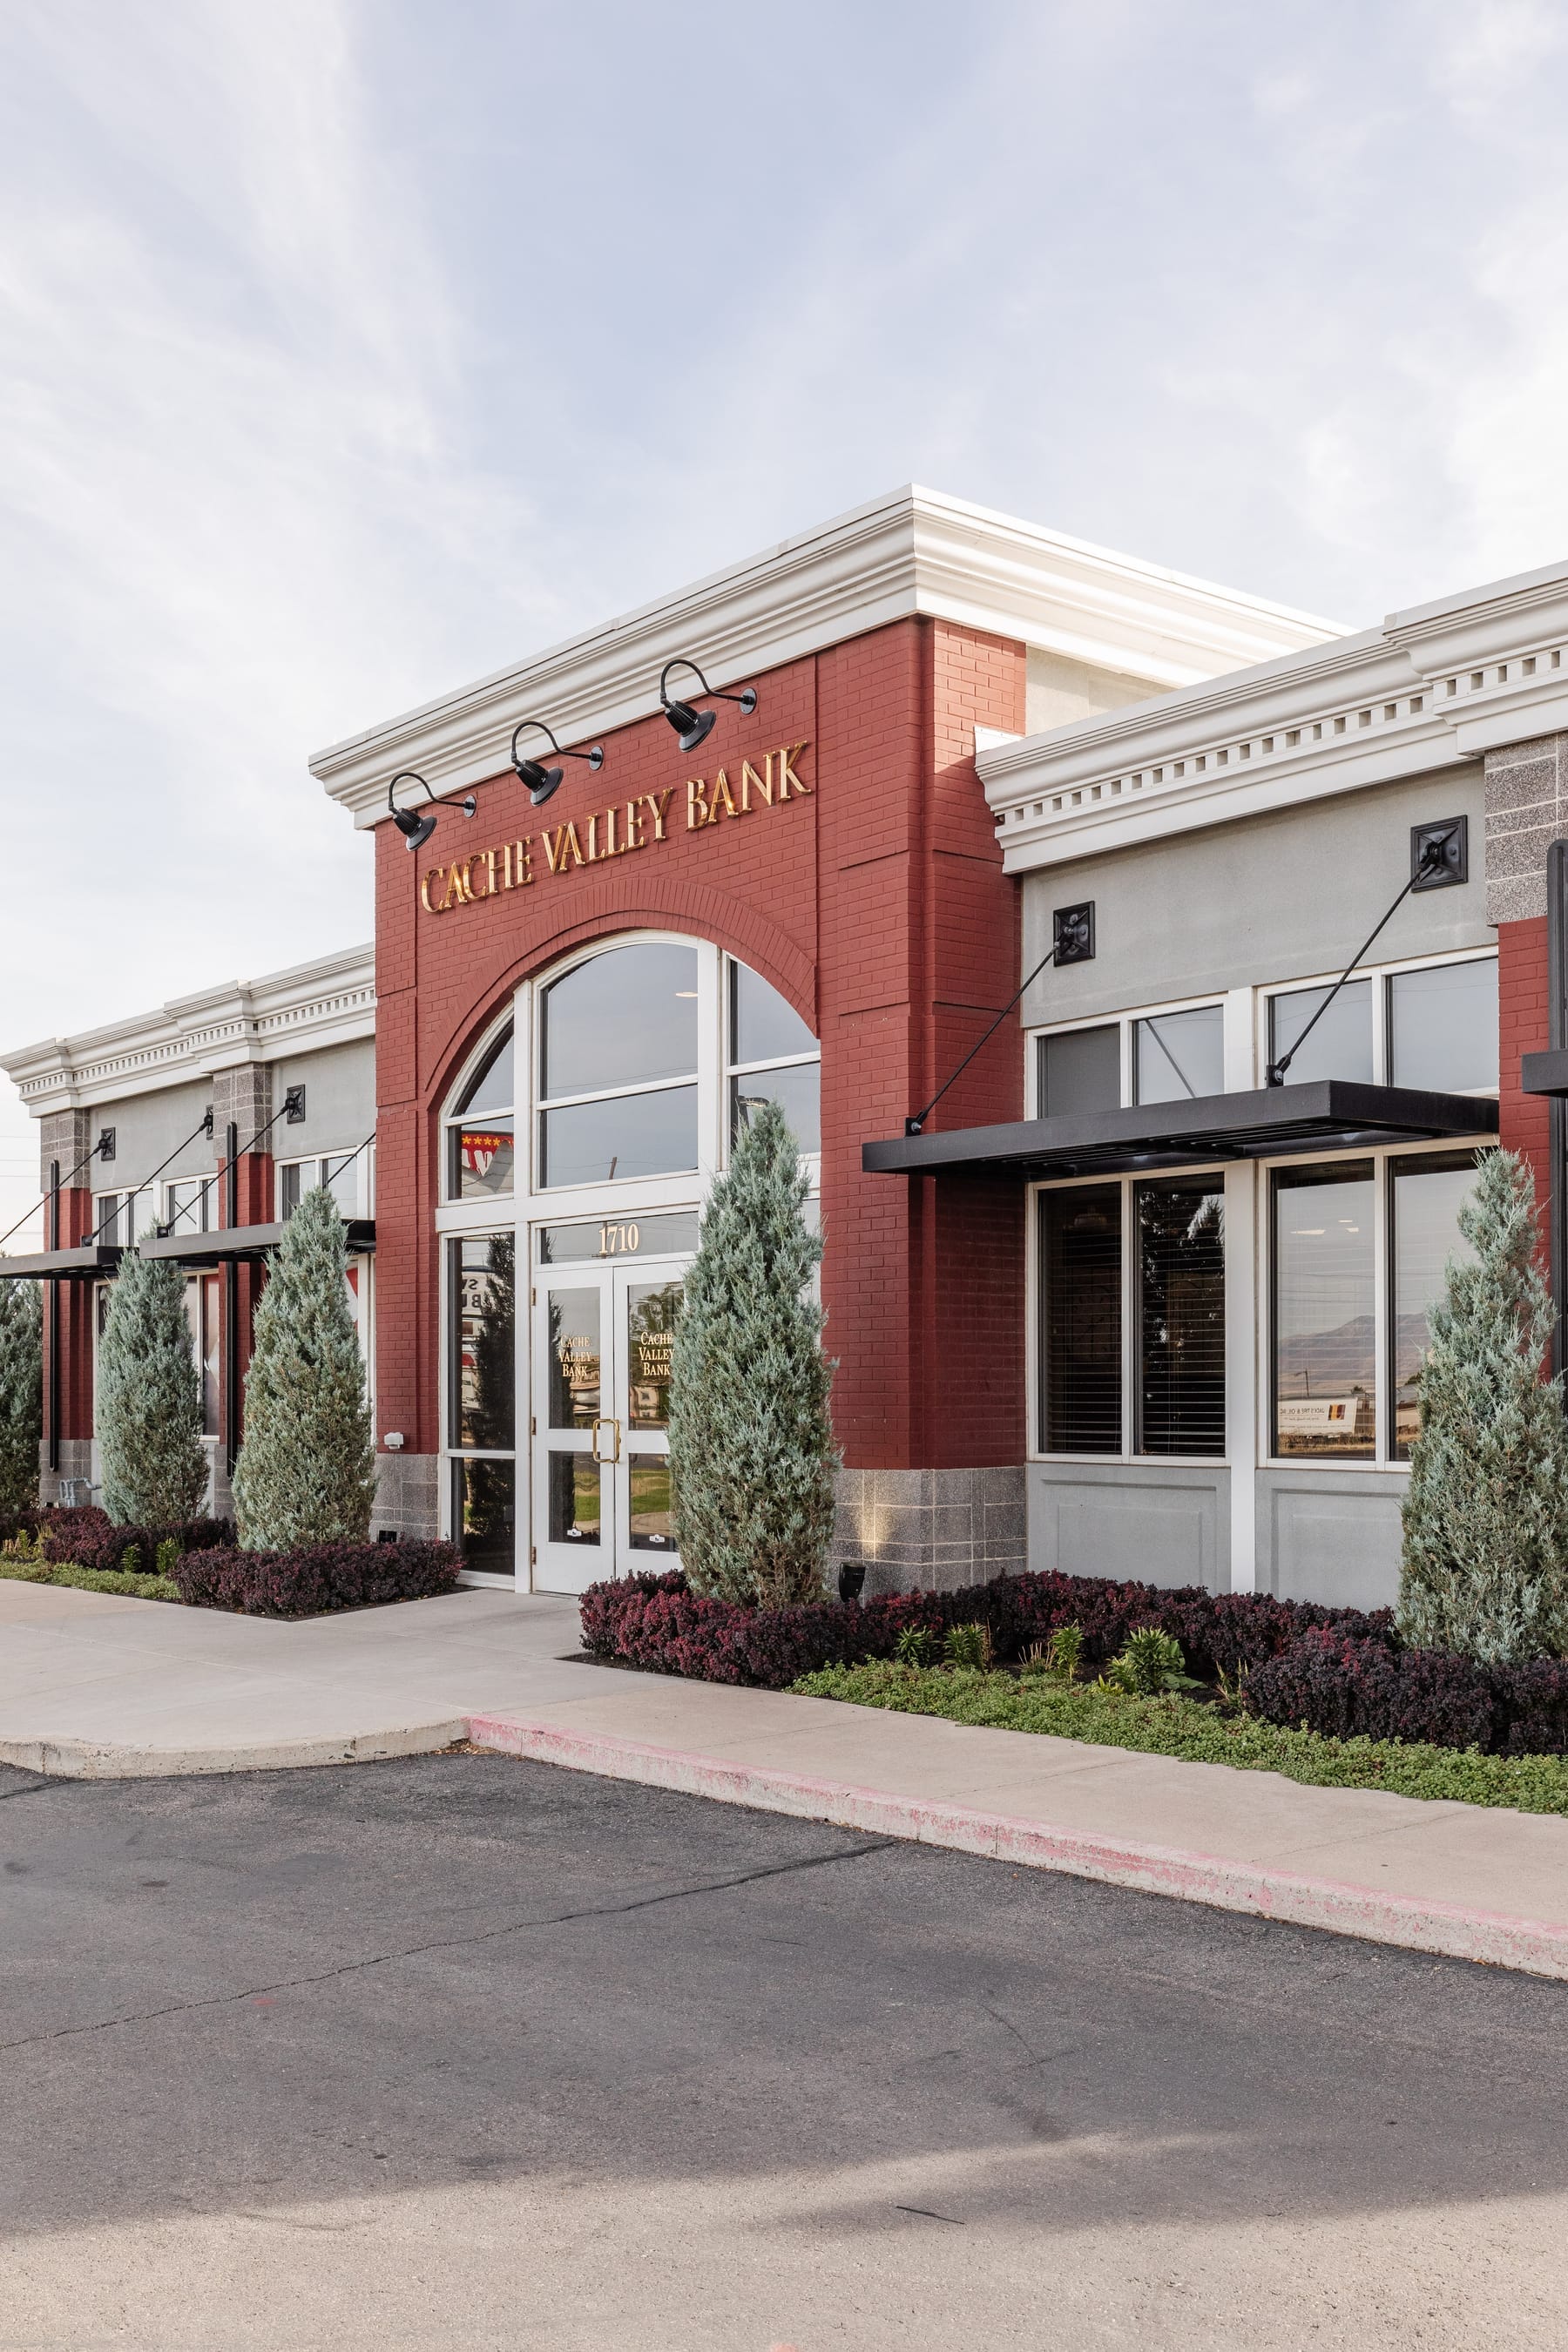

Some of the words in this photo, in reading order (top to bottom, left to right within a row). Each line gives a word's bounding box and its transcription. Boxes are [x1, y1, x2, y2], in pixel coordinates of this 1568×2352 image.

[421, 835, 535, 915] CACHE
[540, 787, 675, 875] VALLEY
[685, 740, 814, 832] BANK
[598, 1223, 640, 1254] 1710
[560, 1335, 591, 1348] CACHE
[640, 1331, 673, 1345] CACHE
[558, 1348, 592, 1362] VALLEY
[639, 1347, 675, 1361] VALLEY
[562, 1363, 588, 1377] BANK
[643, 1362, 671, 1376] BANK
